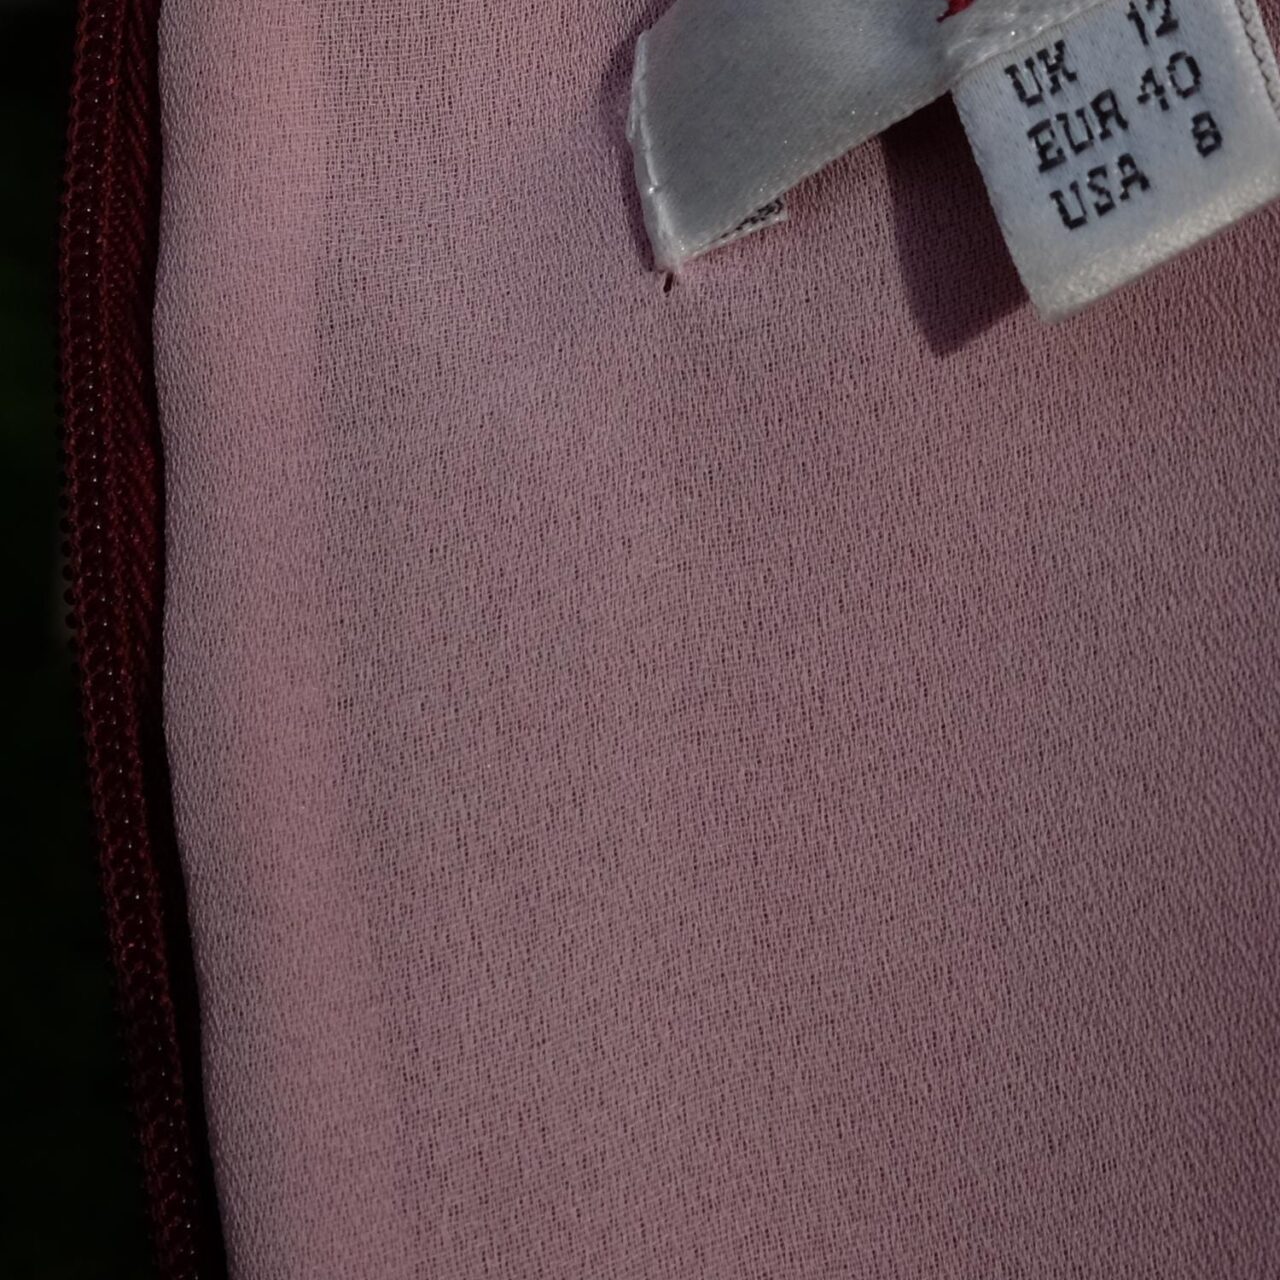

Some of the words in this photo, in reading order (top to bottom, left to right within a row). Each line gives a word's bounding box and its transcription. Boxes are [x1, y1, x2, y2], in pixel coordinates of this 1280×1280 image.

[1005, 40, 1077, 106] UK
[1027, 89, 1128, 172] EUR
[1136, 51, 1201, 111] 40
[1050, 152, 1150, 229] USA
[1192, 111, 1223, 158] 8
